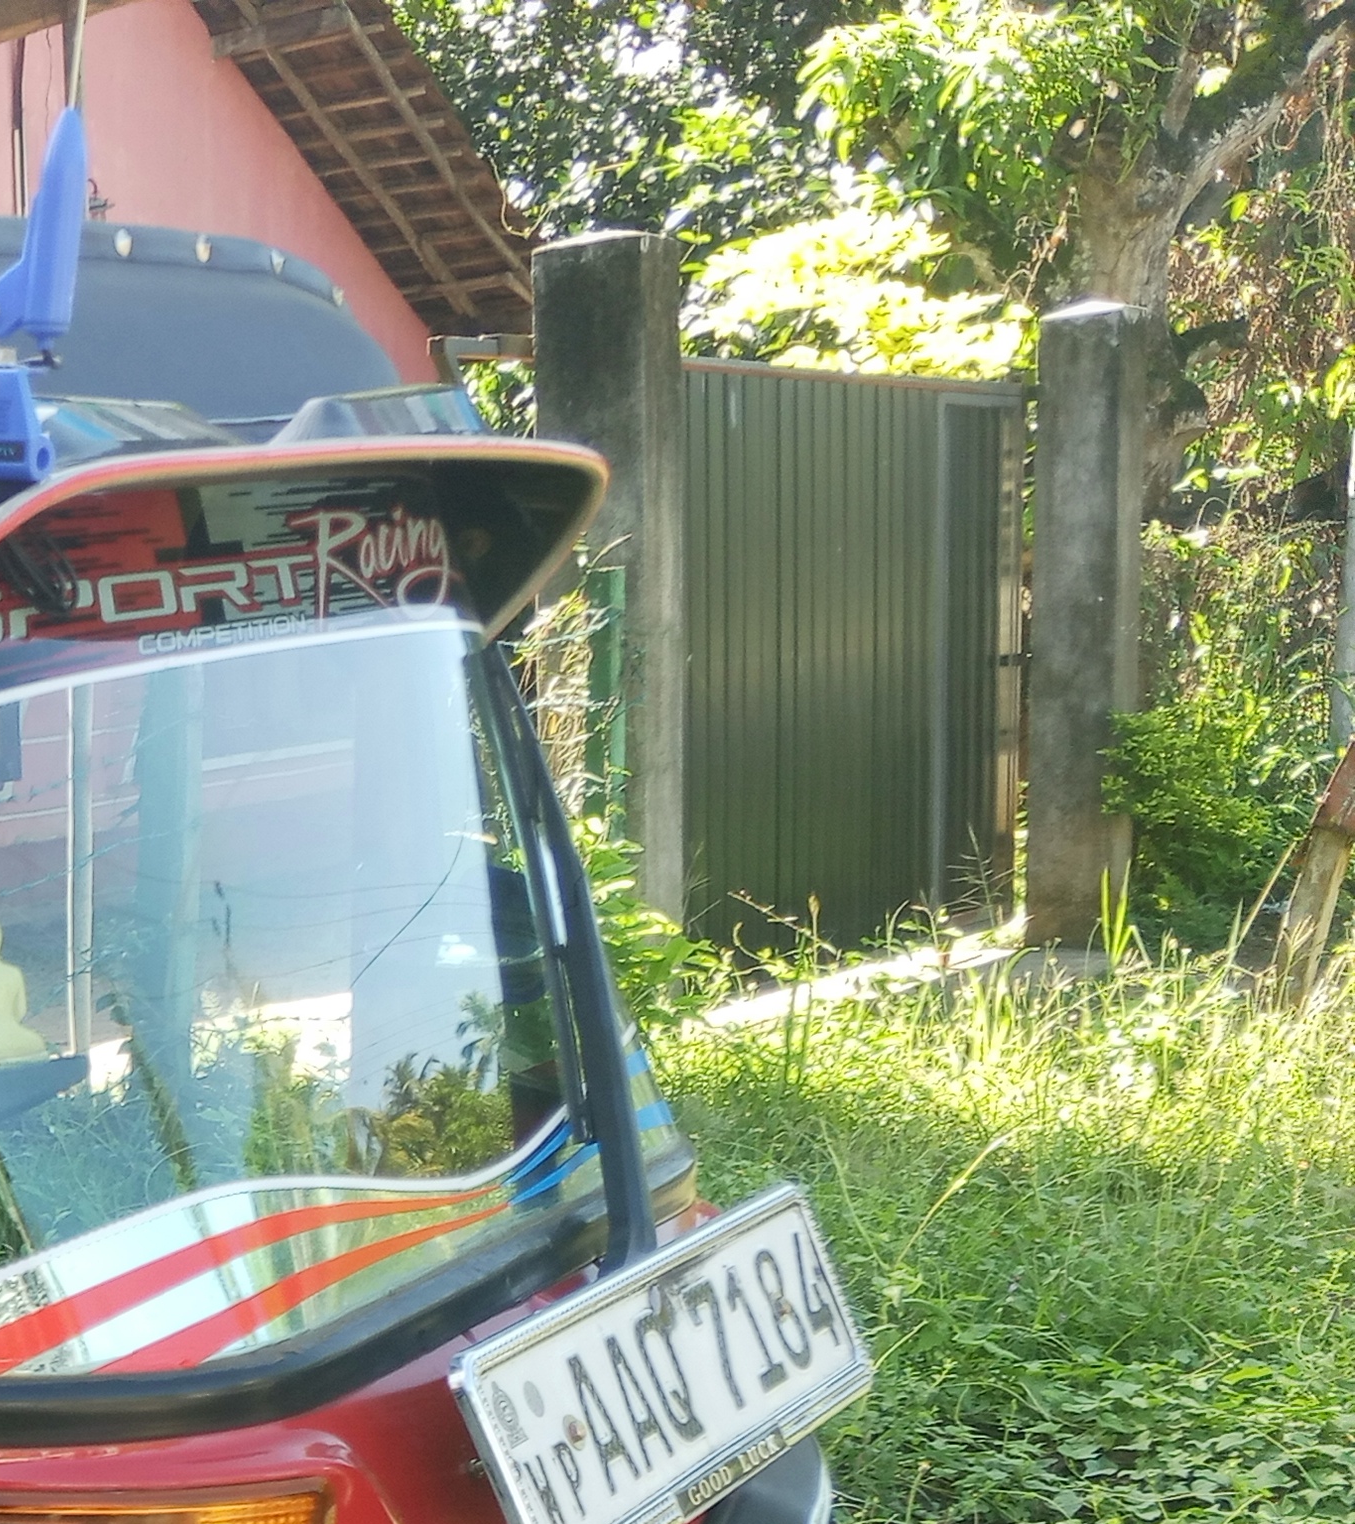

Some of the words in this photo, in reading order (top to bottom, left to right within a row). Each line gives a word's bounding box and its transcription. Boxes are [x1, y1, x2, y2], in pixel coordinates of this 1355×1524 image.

[291, 506, 451, 631] Racing
[138, 611, 308, 655] COMPETITION
[566, 1307, 705, 1497] AAQ
[682, 1231, 841, 1411] 7184
[687, 1466, 733, 1507] GOOD
[740, 1432, 782, 1473] LUCK
